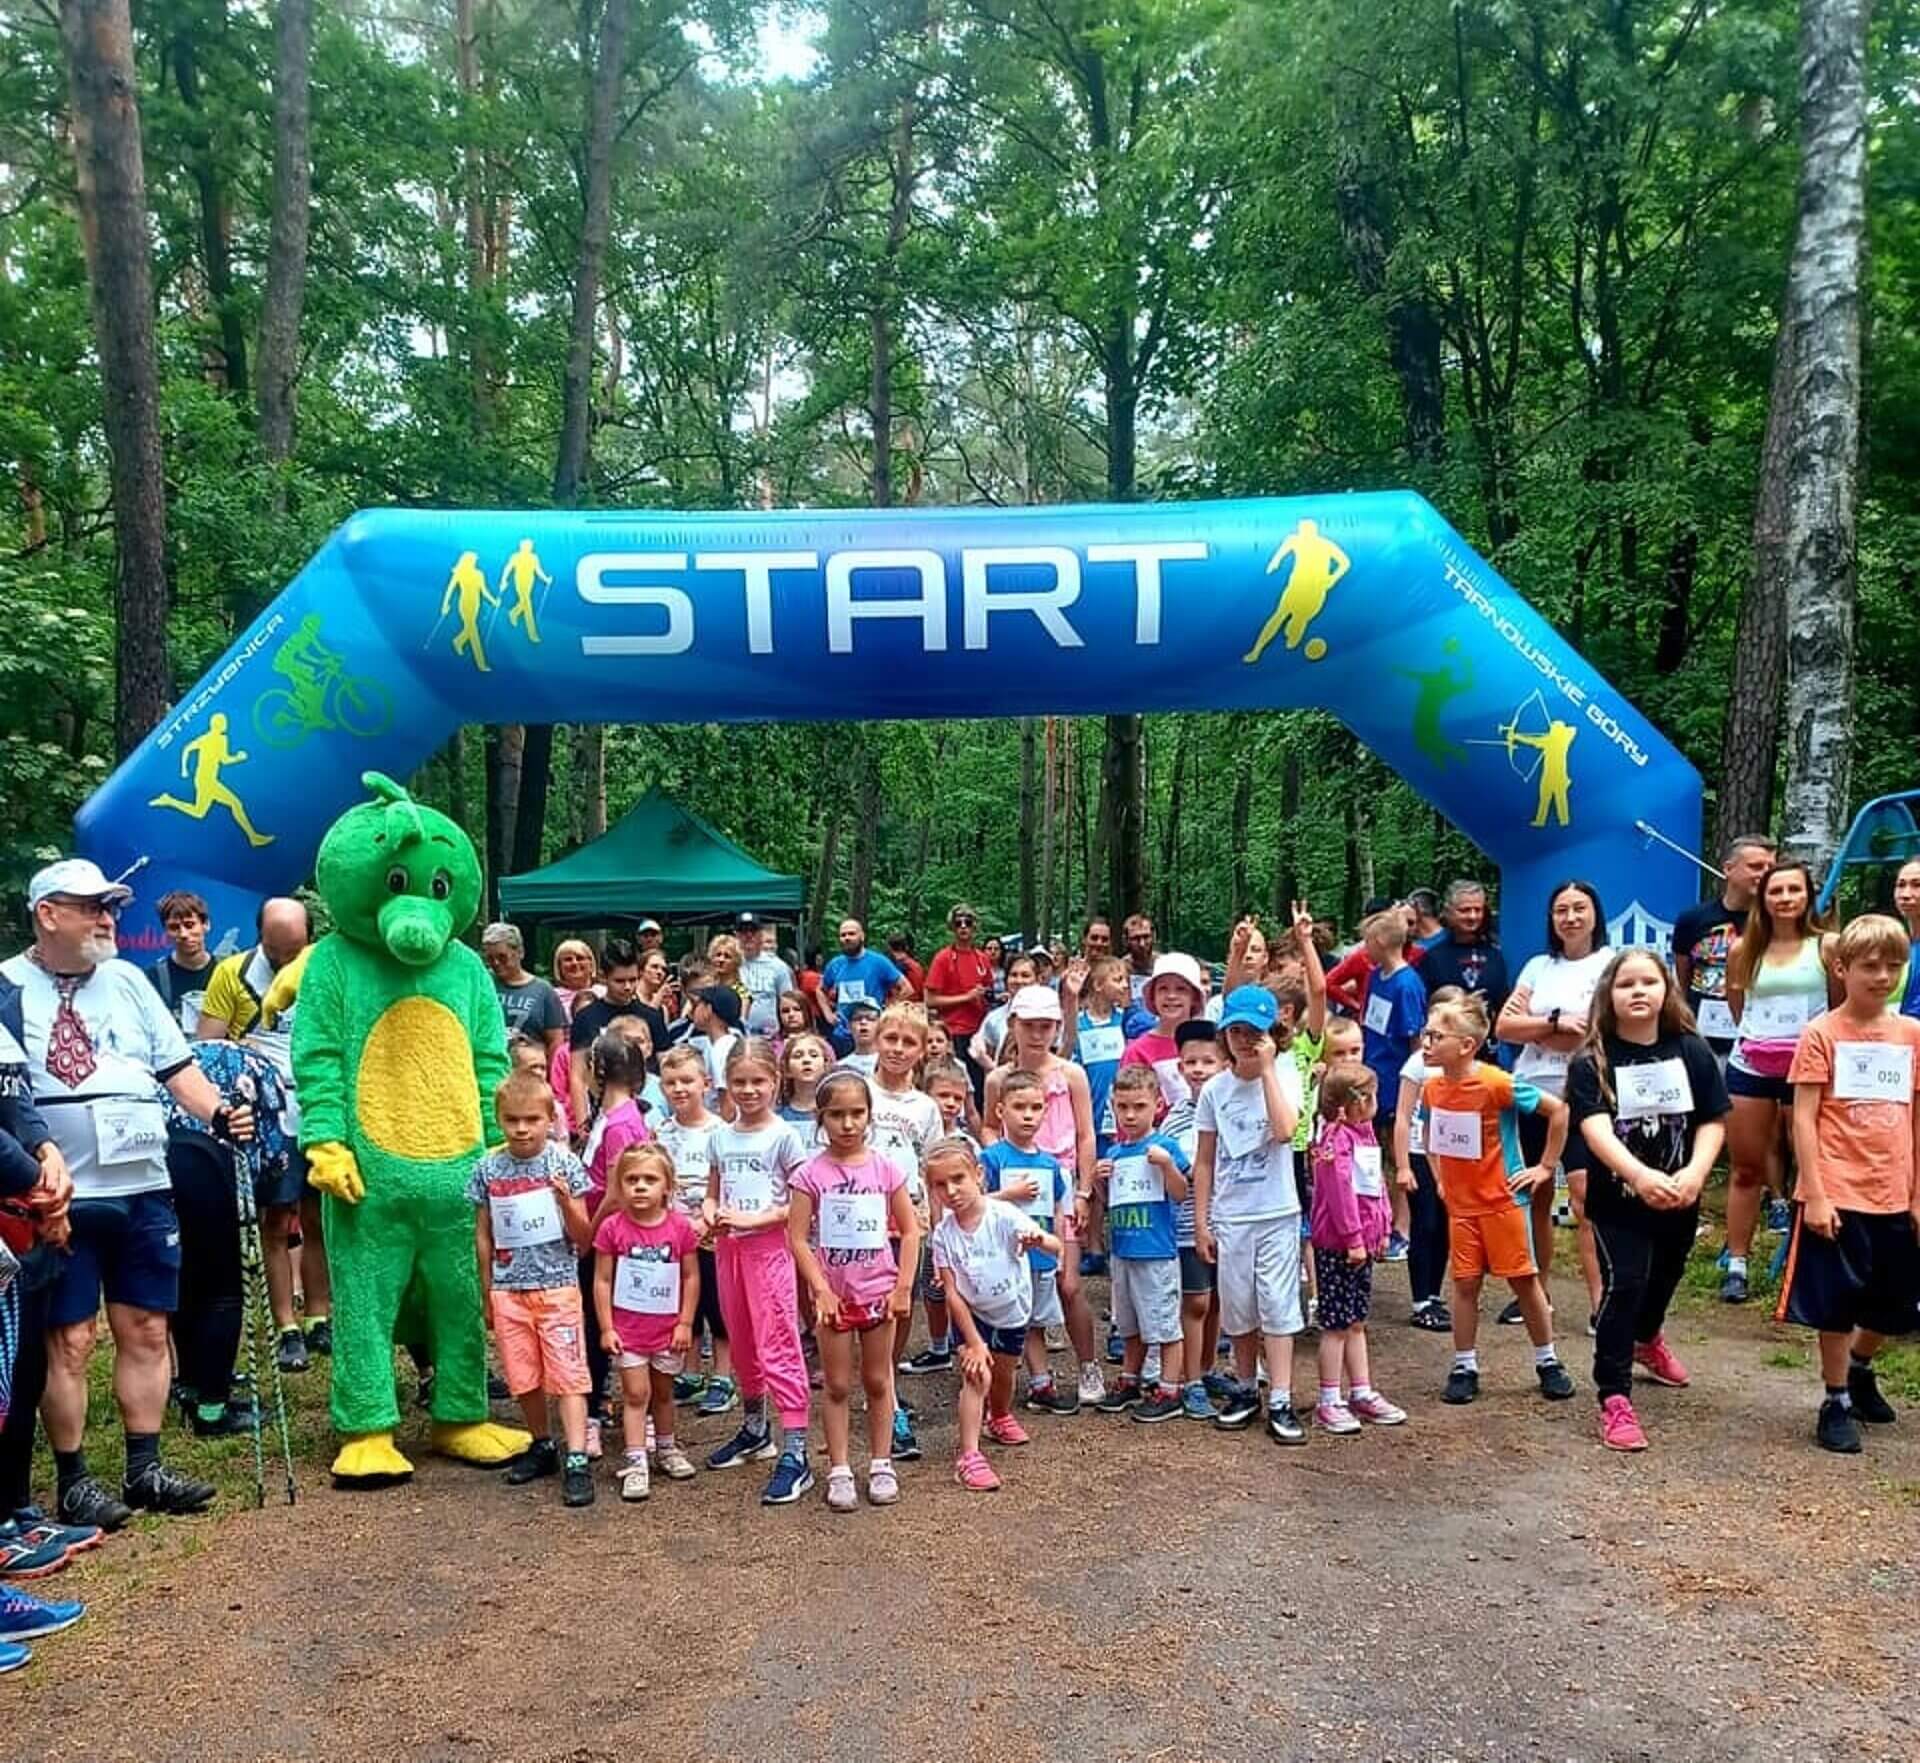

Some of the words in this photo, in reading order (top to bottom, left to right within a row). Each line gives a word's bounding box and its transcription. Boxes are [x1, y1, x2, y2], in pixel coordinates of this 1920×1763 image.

[576, 542, 1208, 656] START
[1444, 562, 1587, 708] TARNOWSKIE
[1586, 702, 1649, 768] GÓRY
[738, 1198, 759, 1211] 123
[522, 1216, 546, 1232] 047
[856, 1219, 878, 1232] 252
